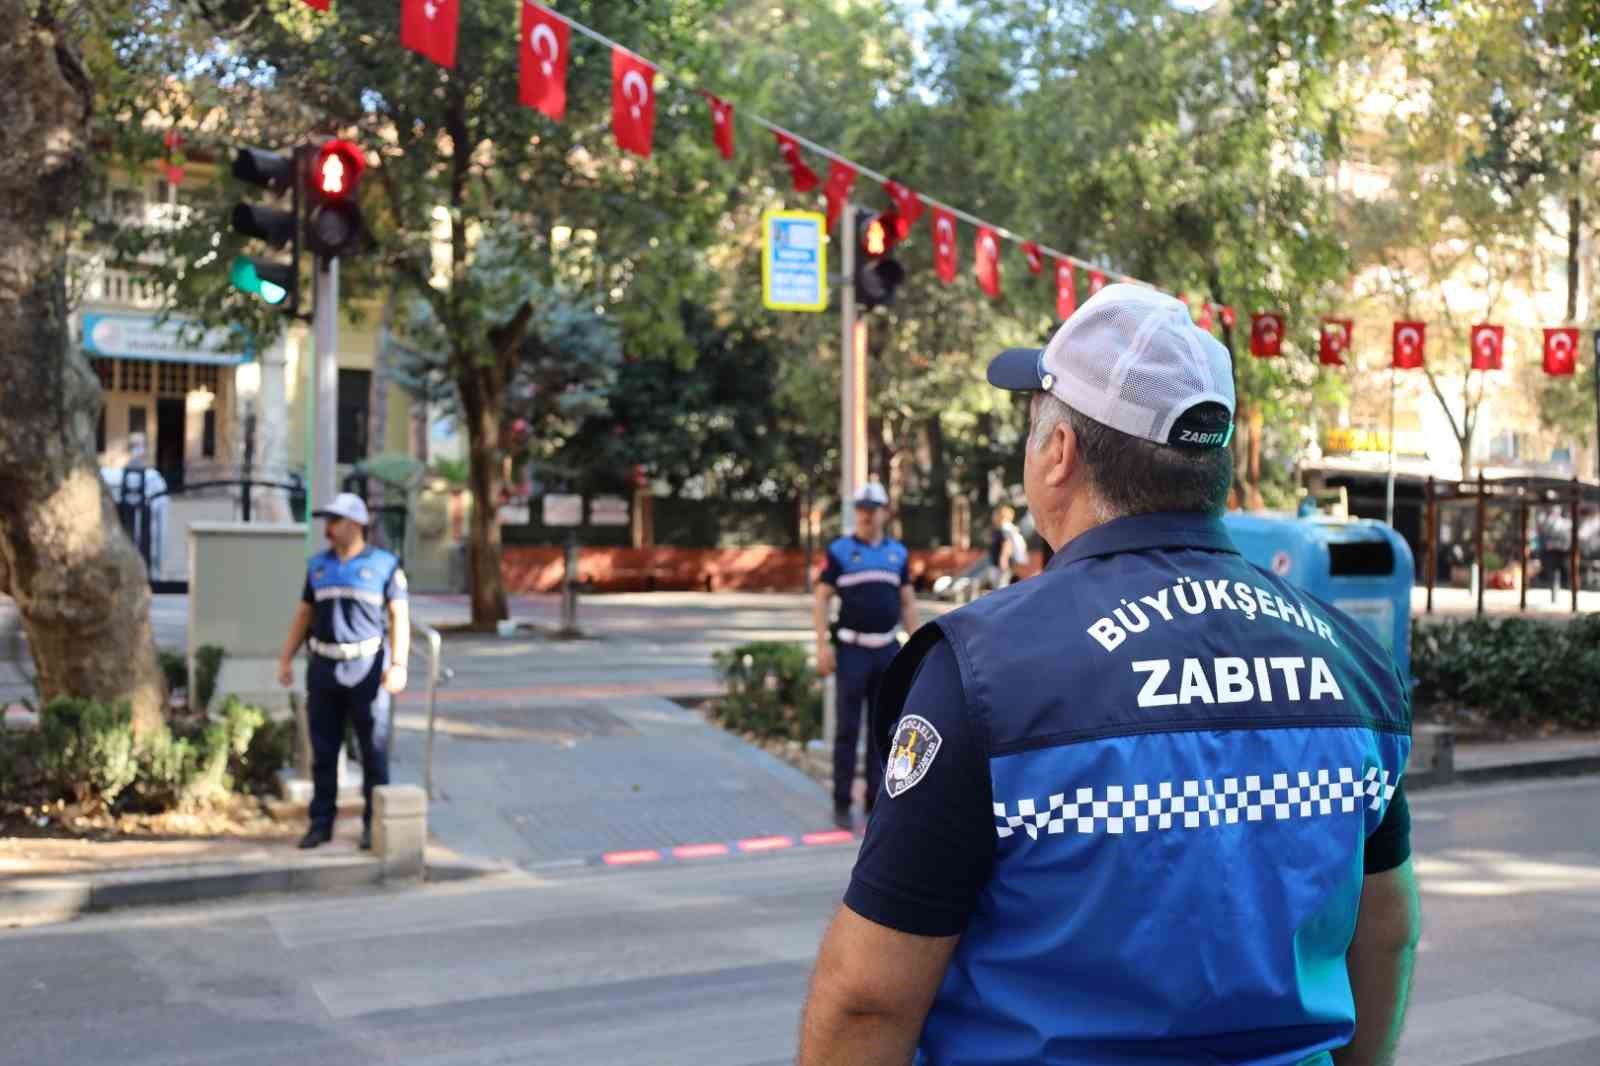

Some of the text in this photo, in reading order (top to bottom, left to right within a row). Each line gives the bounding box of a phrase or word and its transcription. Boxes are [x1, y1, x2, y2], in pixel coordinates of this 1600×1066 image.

[1179, 430, 1223, 445] ZABITA
[1086, 576, 1339, 652] BÜYÜKŞEHİR
[1131, 657, 1344, 708] ZABITA
